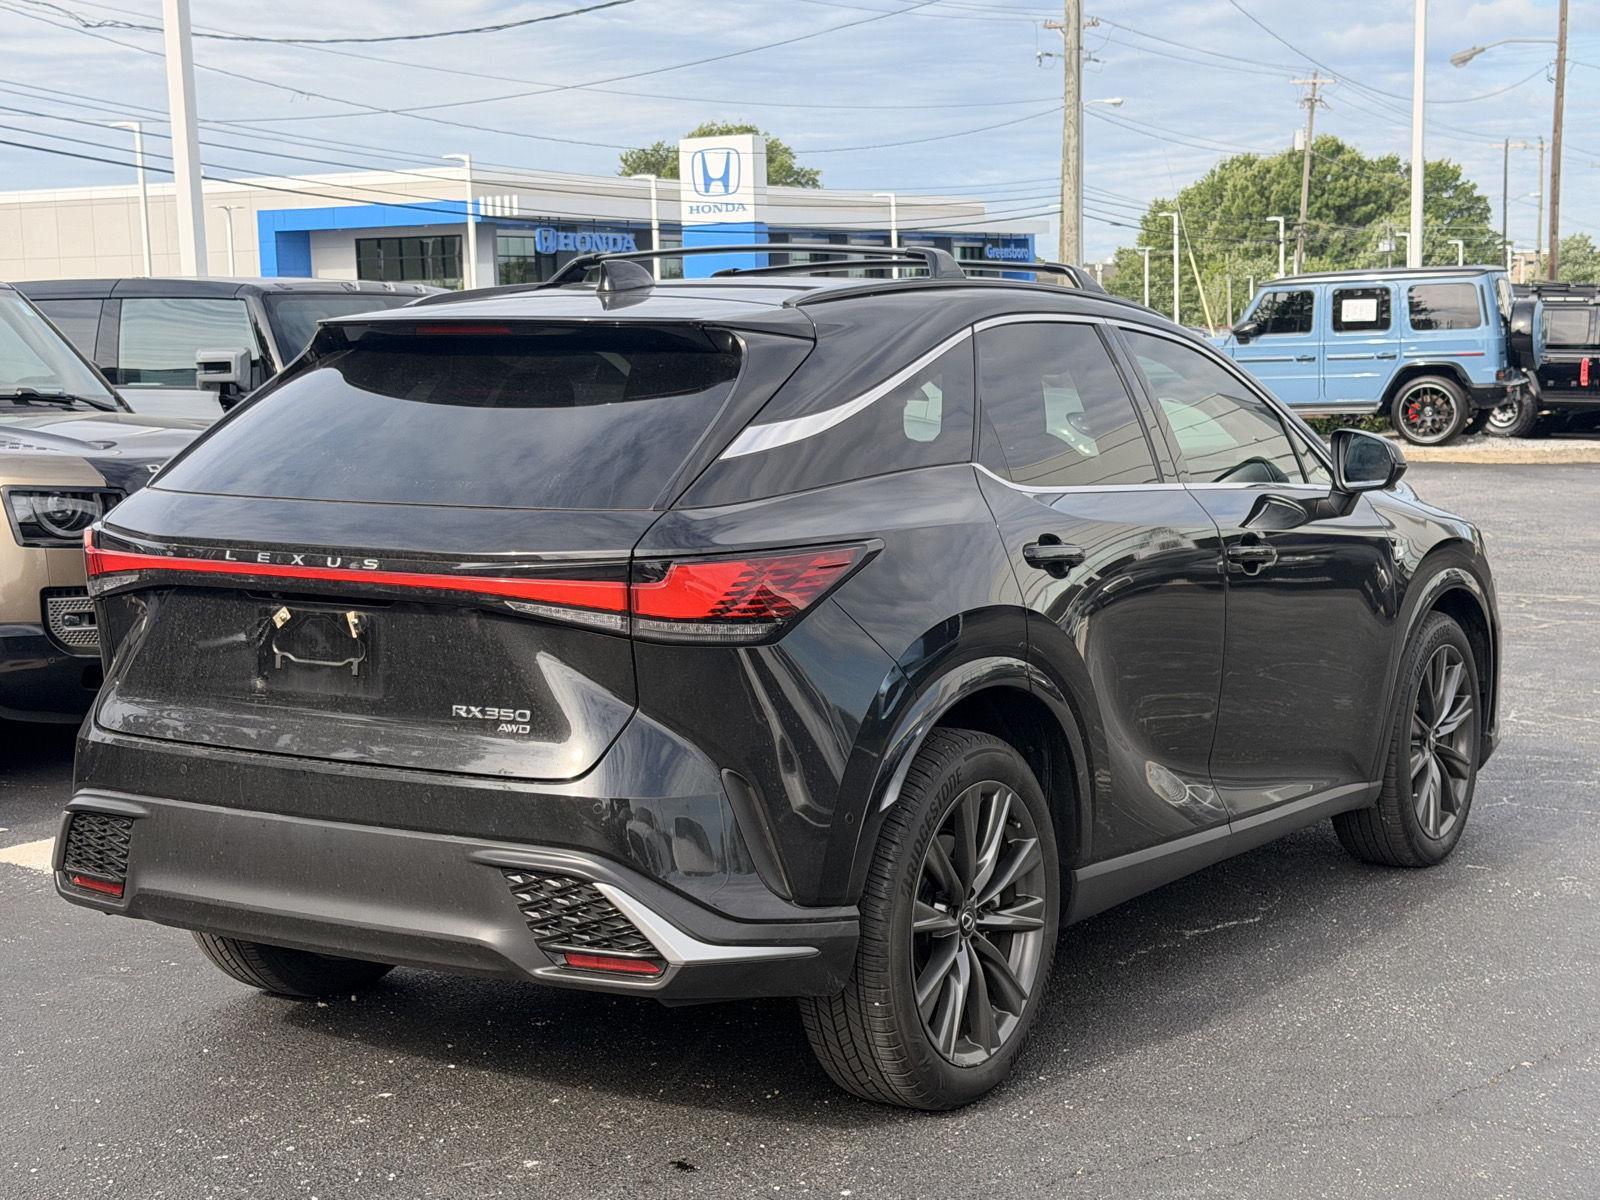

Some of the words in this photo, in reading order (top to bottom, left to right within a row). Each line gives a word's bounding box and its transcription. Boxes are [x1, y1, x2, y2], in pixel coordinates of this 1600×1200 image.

[688, 203, 747, 214] HONDA
[557, 232, 639, 252] HONDA
[985, 243, 1029, 258] Greensboro
[225, 550, 378, 570] LEXUS
[452, 705, 531, 721] RX350
[497, 724, 531, 734] AWD
